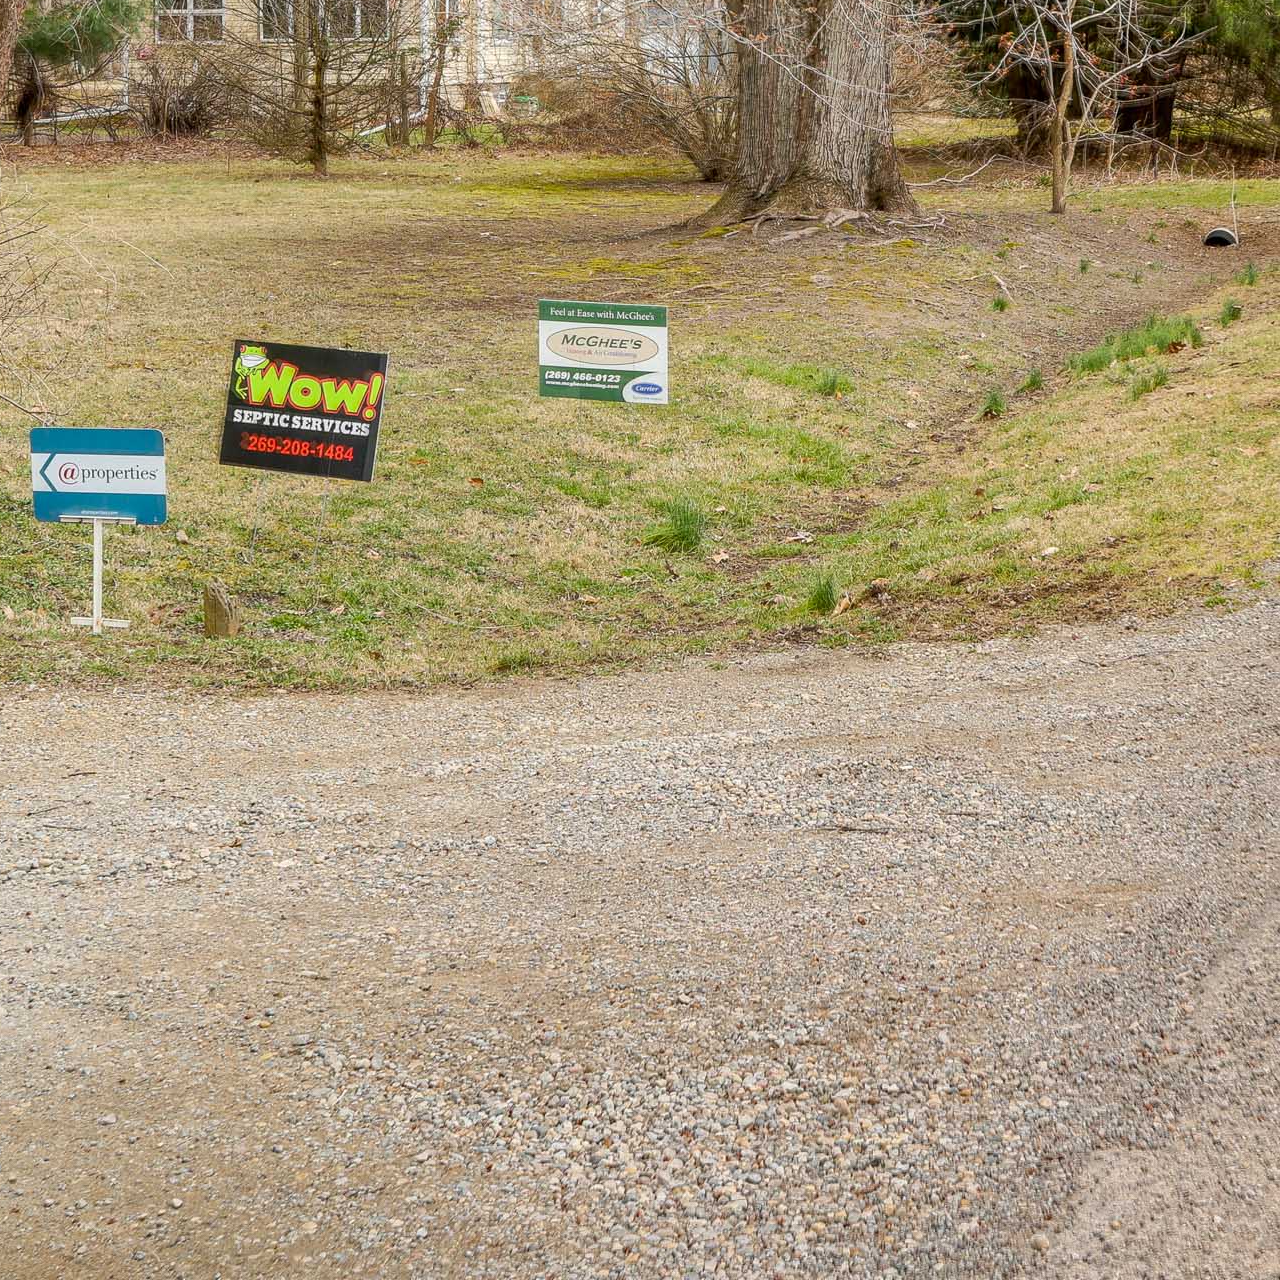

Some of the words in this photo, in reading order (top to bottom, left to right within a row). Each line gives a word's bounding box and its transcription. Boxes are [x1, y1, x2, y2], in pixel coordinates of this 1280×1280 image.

[550, 307, 566, 316] Feel
[567, 308, 575, 317] at
[577, 308, 595, 318] Ease
[596, 310, 614, 319] with
[616, 311, 655, 321] McGhee's
[545, 370, 571, 381] (269)
[573, 372, 621, 383] 466-0123
[635, 385, 660, 393] Carrier
[233, 409, 291, 428] SEPTIC
[291, 415, 371, 436] SERVICES
[247, 435, 354, 462] 269-208-1484
[58, 462, 157, 485] @properties
